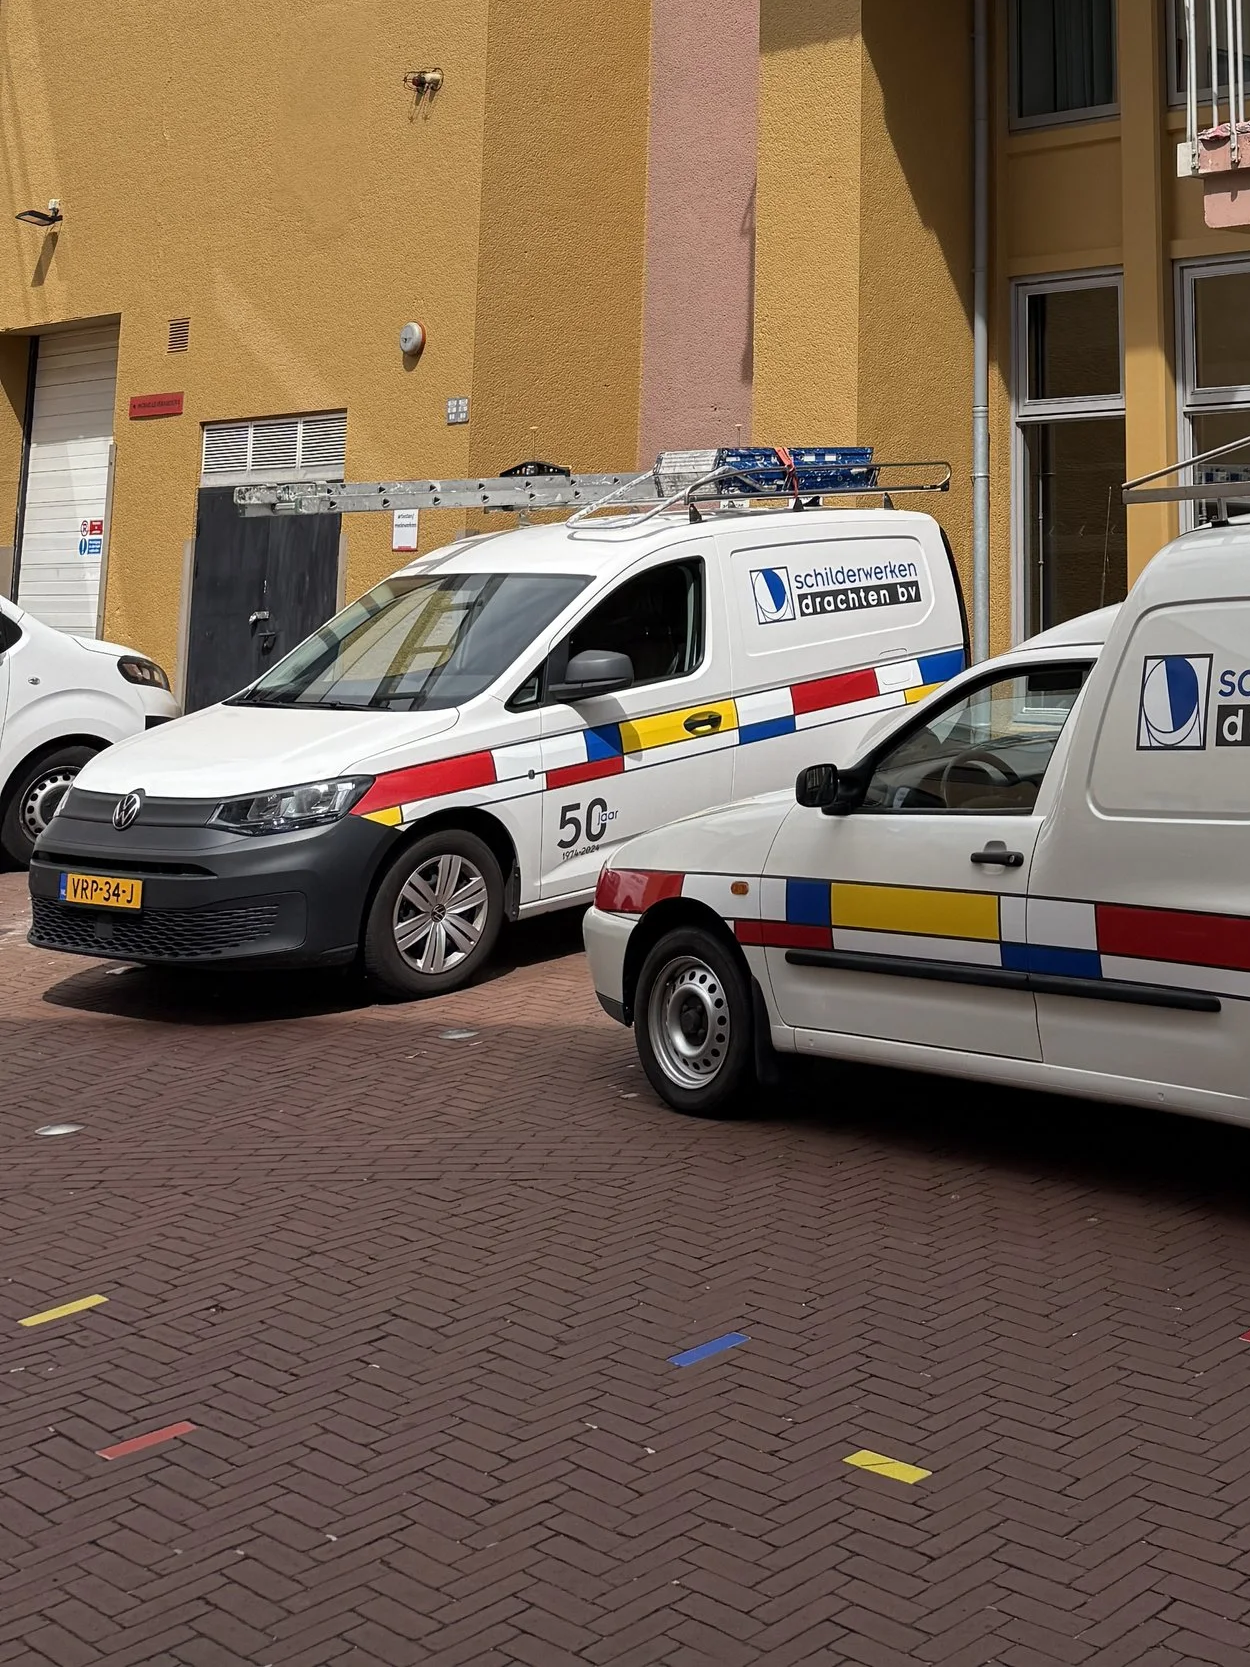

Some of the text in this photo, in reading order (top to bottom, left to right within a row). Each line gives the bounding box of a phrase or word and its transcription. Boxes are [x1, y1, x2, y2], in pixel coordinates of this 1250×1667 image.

[795, 561, 917, 589] schilderwerken
[802, 584, 917, 614] drachten bv
[557, 798, 618, 848] 50 jaar
[562, 845, 599, 860] 1974-2024
[72, 877, 134, 904] VRP-34-J
